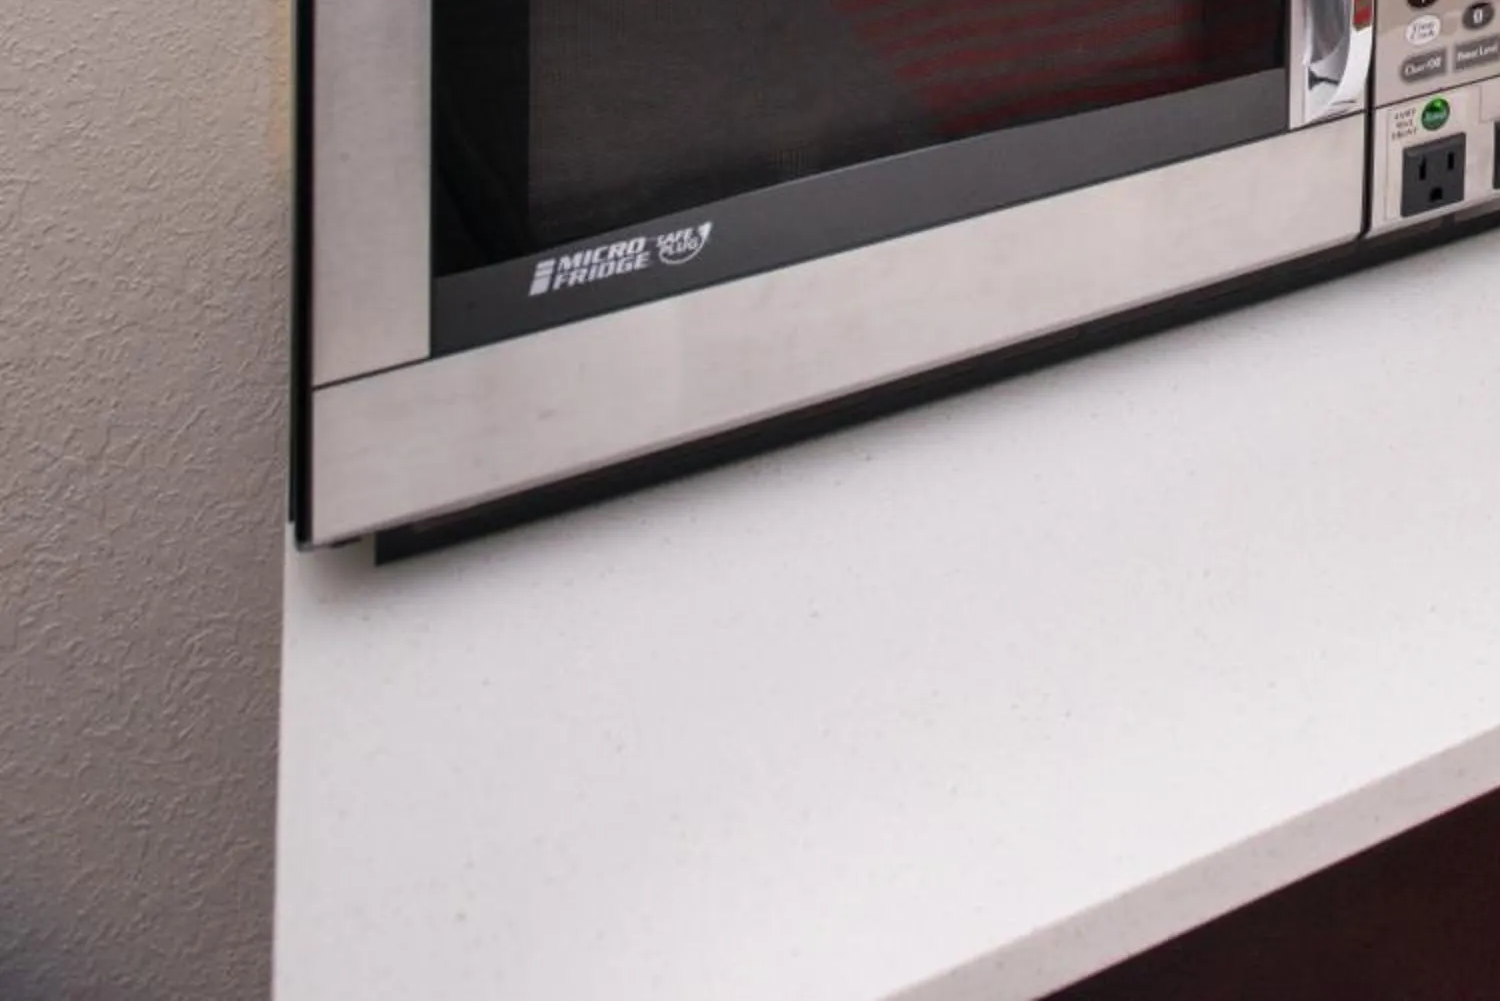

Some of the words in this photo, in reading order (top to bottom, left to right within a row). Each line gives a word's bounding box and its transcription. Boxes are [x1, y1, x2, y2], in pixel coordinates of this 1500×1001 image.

[1472, 8, 1484, 25] 0
[552, 250, 651, 291] FRIDGE
[558, 236, 647, 273] MICRO
